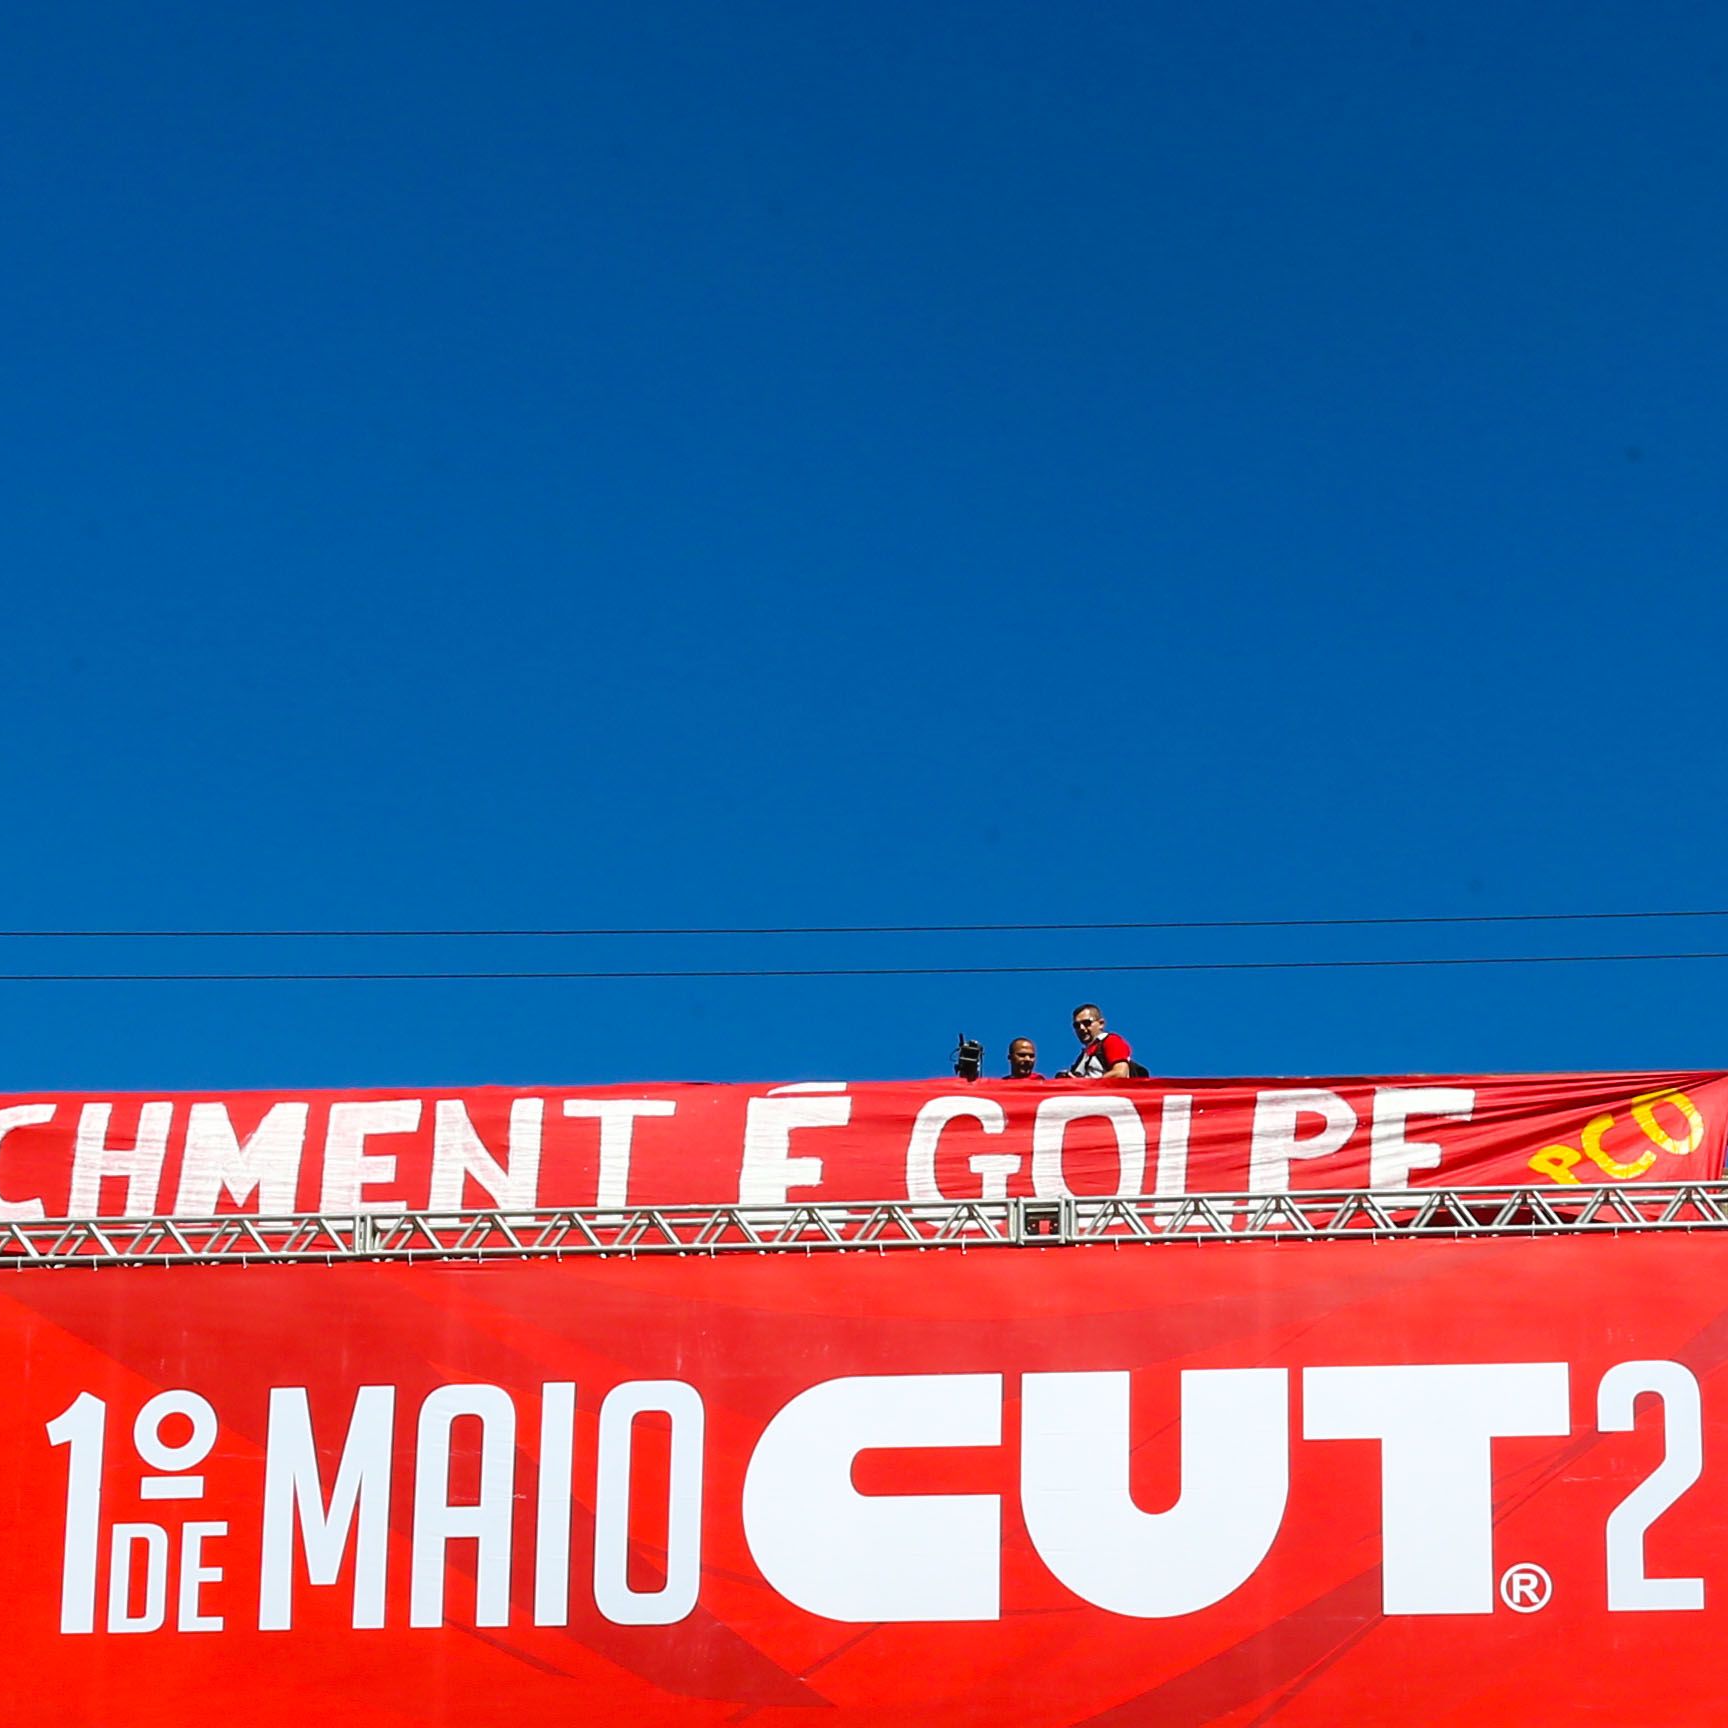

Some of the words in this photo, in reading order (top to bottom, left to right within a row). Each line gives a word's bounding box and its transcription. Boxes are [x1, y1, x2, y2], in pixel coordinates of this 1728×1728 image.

[906, 1087, 1474, 1230] GOLPE
[1526, 1087, 1706, 1188] PCO
[109, 1521, 227, 1634] DE
[258, 1380, 706, 1630] MAIO
[742, 1362, 1570, 1623] CUT
